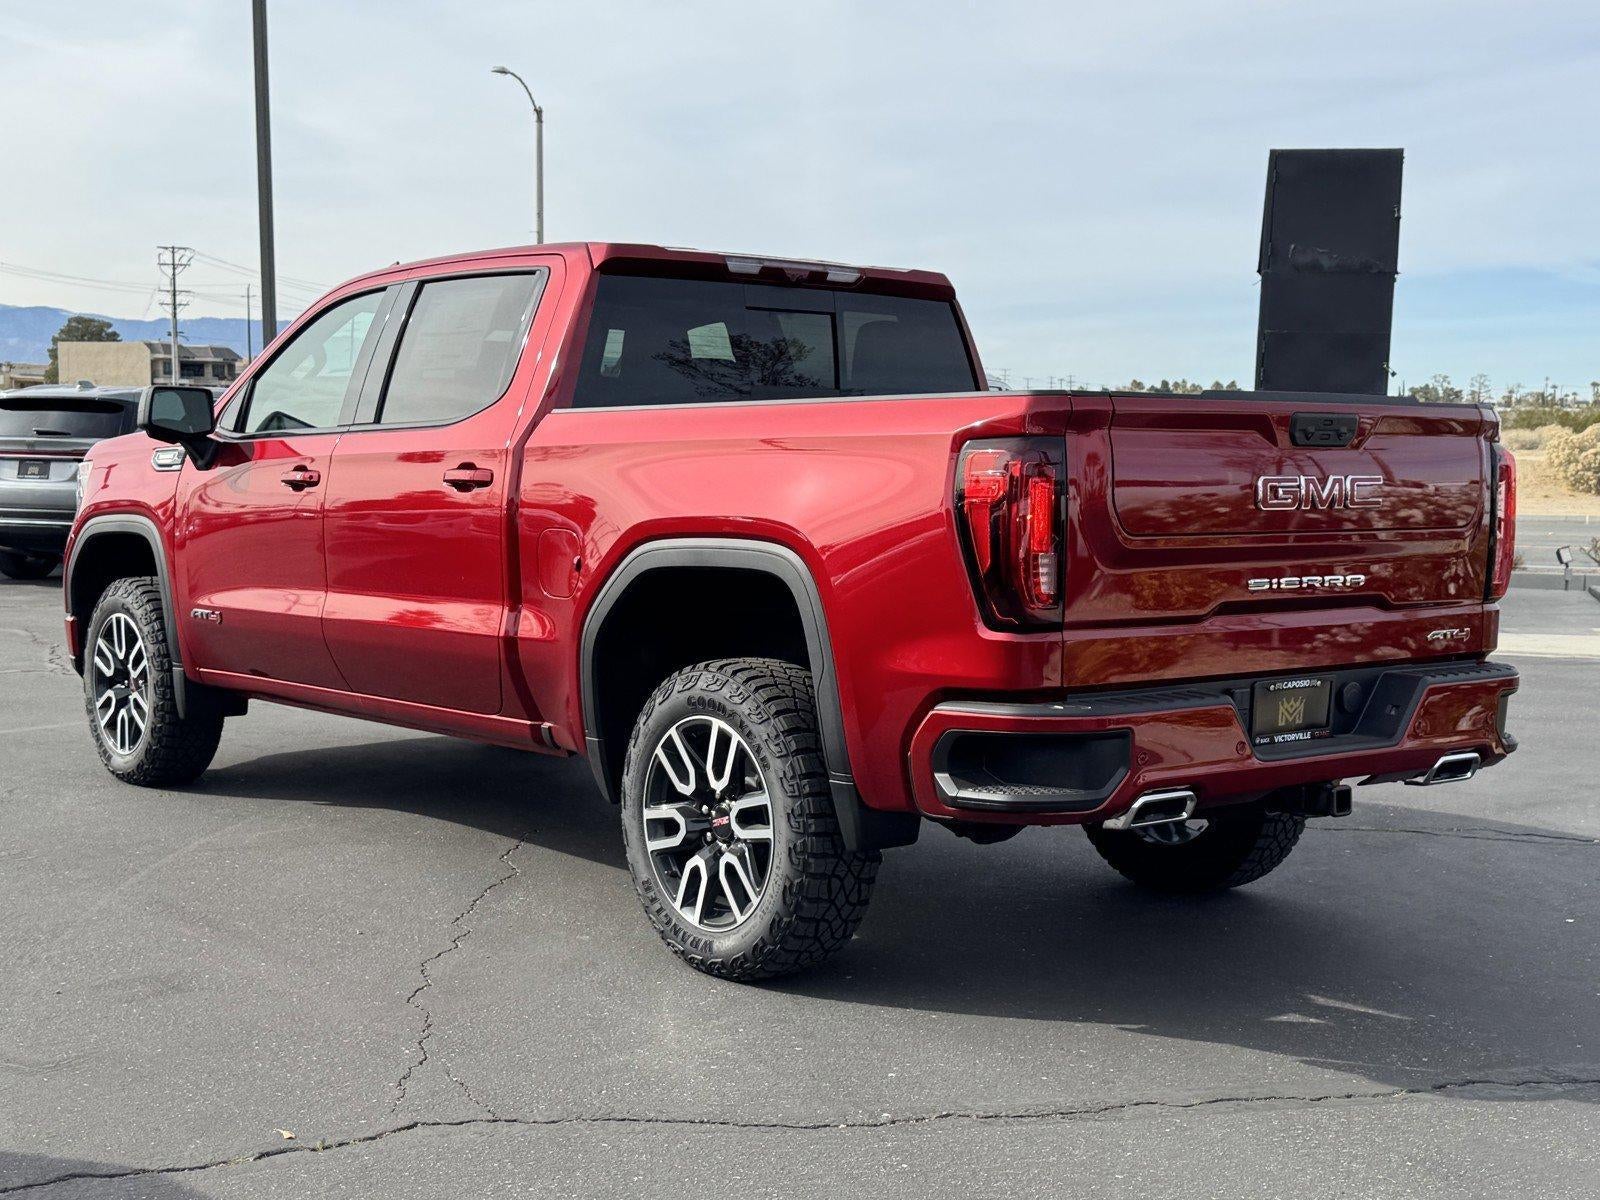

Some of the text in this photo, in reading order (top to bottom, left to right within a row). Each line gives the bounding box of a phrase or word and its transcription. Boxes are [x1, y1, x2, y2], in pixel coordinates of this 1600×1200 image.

[1257, 475, 1383, 511] GMC
[1248, 574, 1366, 590] SIERRA
[190, 608, 222, 624] AT4
[1427, 627, 1471, 641] AT4
[1282, 680, 1310, 689] CAPOSIO
[1274, 732, 1311, 743] VICTORVILLE
[642, 879, 714, 953] WRANGLER
